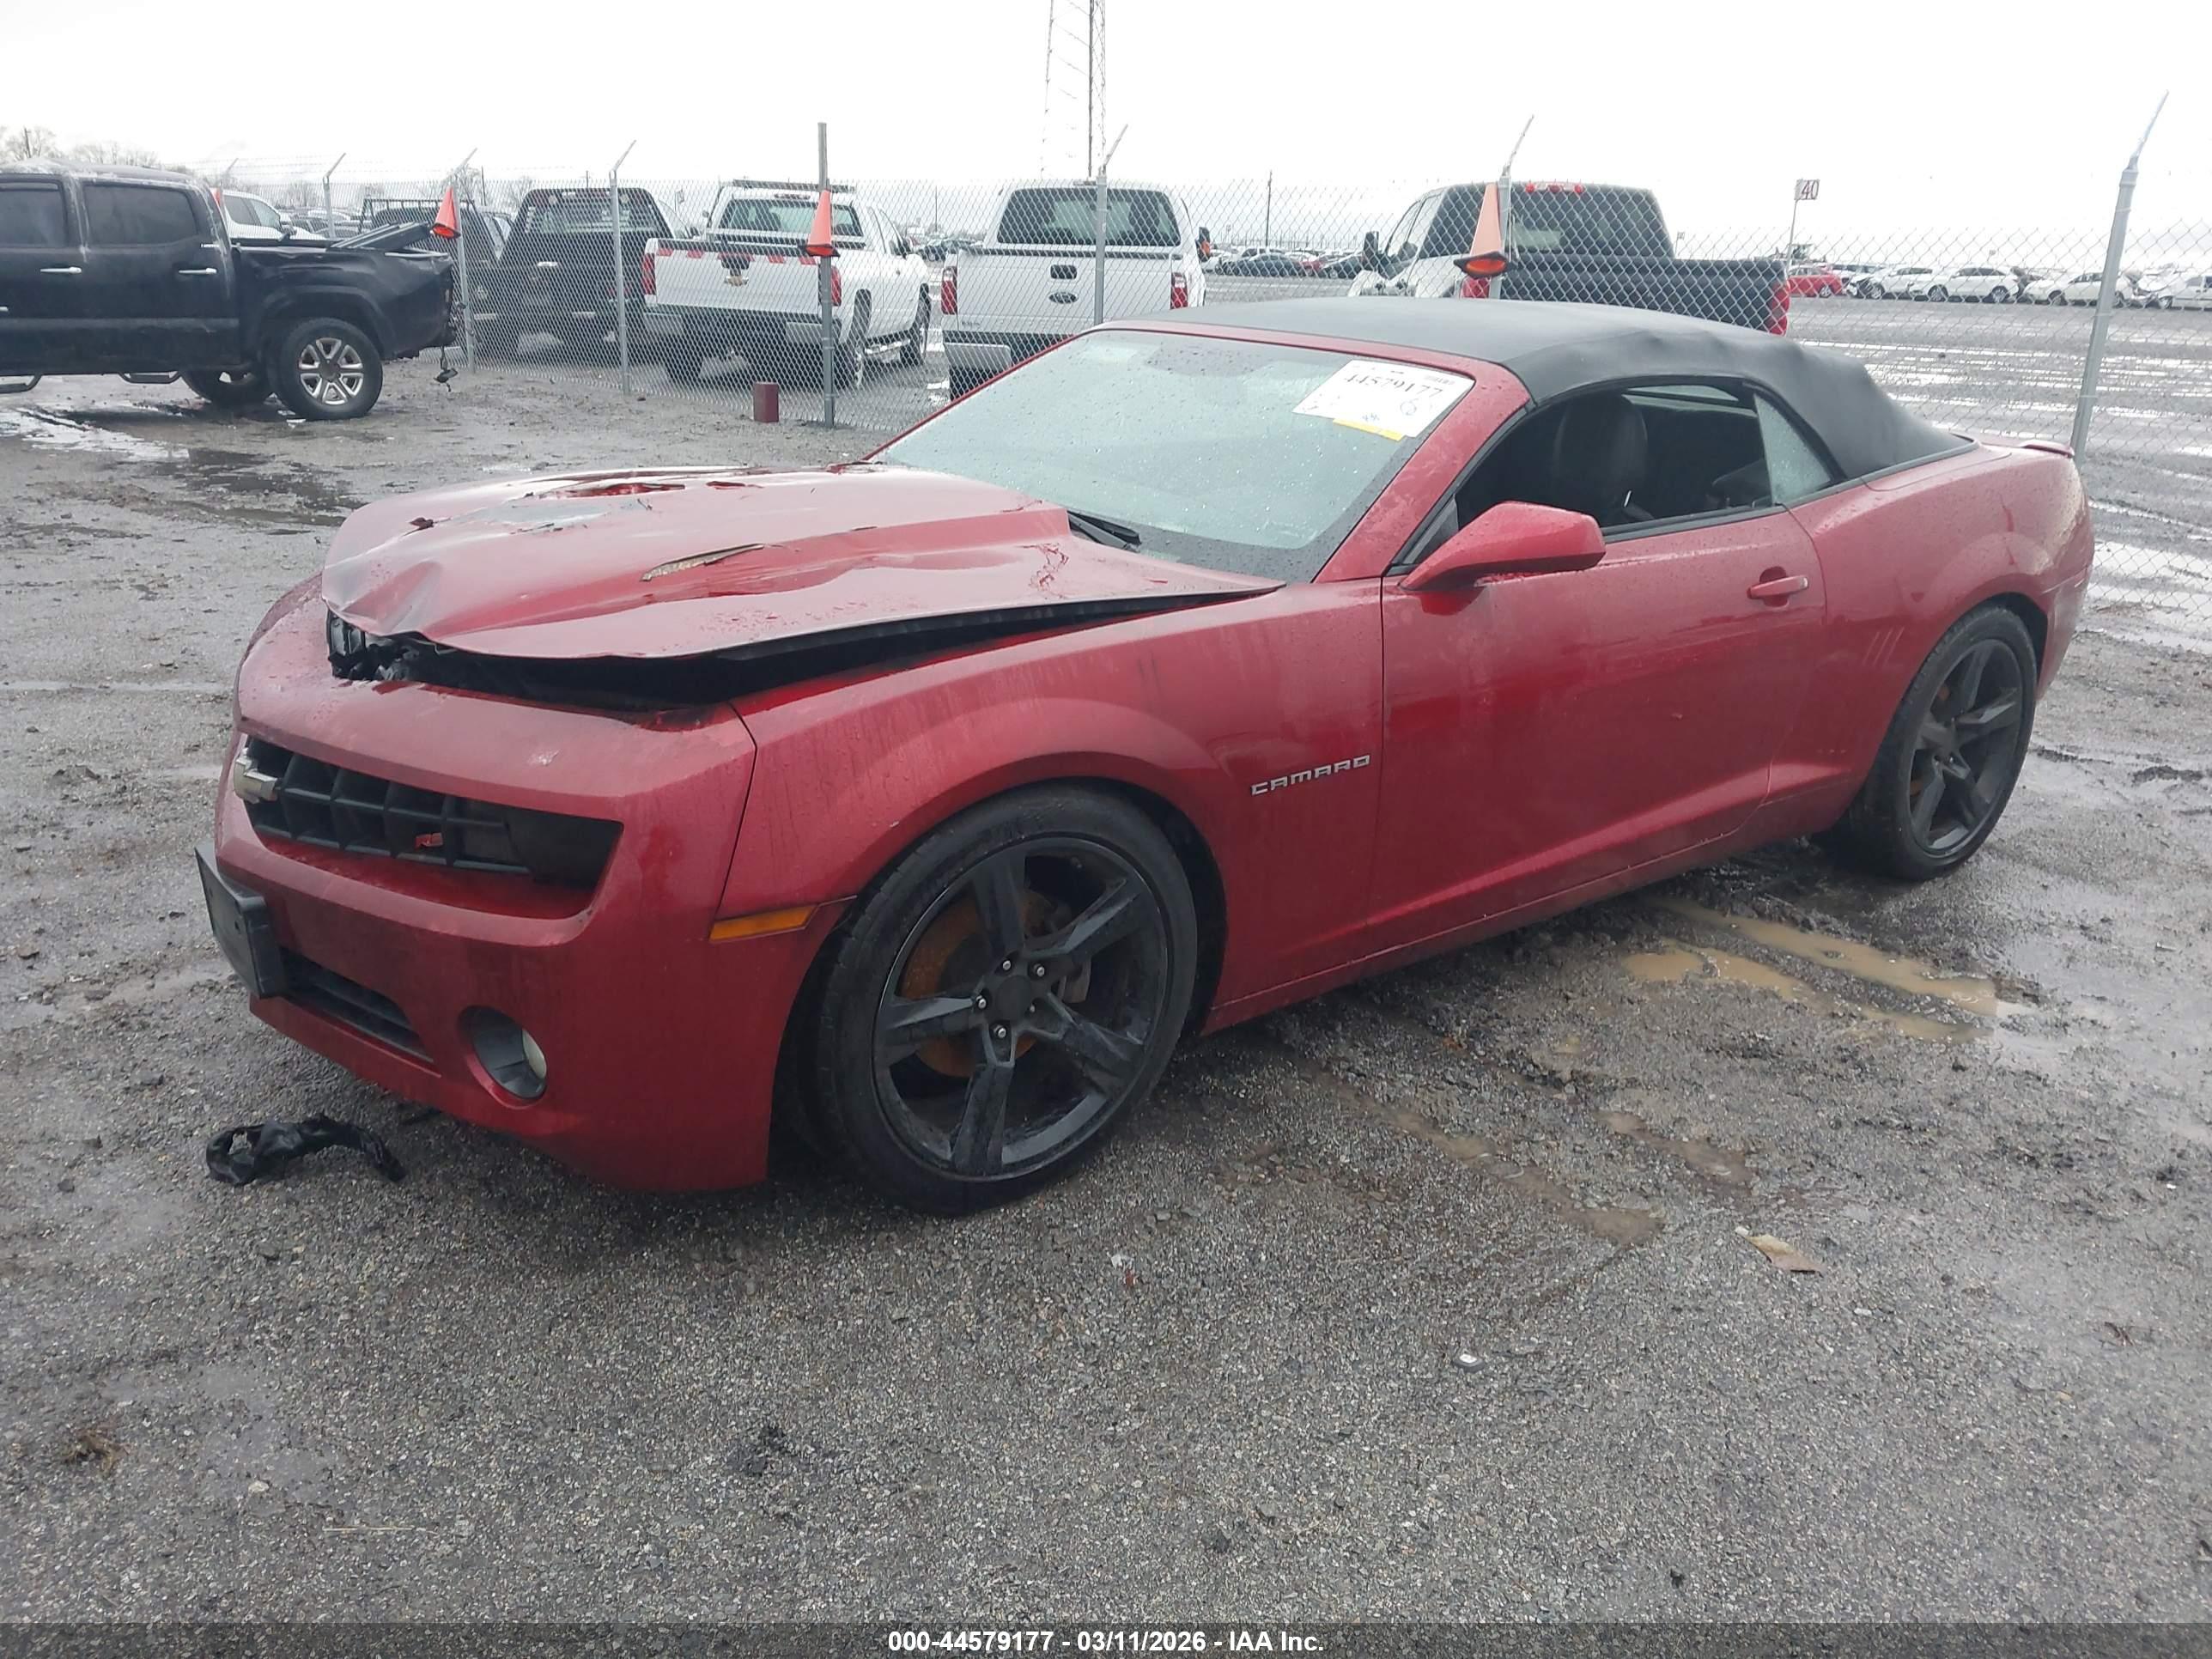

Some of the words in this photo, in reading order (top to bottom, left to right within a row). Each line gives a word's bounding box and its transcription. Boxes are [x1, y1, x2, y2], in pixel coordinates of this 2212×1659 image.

[1802, 179, 1820, 200] 40
[1344, 373, 1443, 398] 44579177
[1251, 755, 1370, 795] CAMARO
